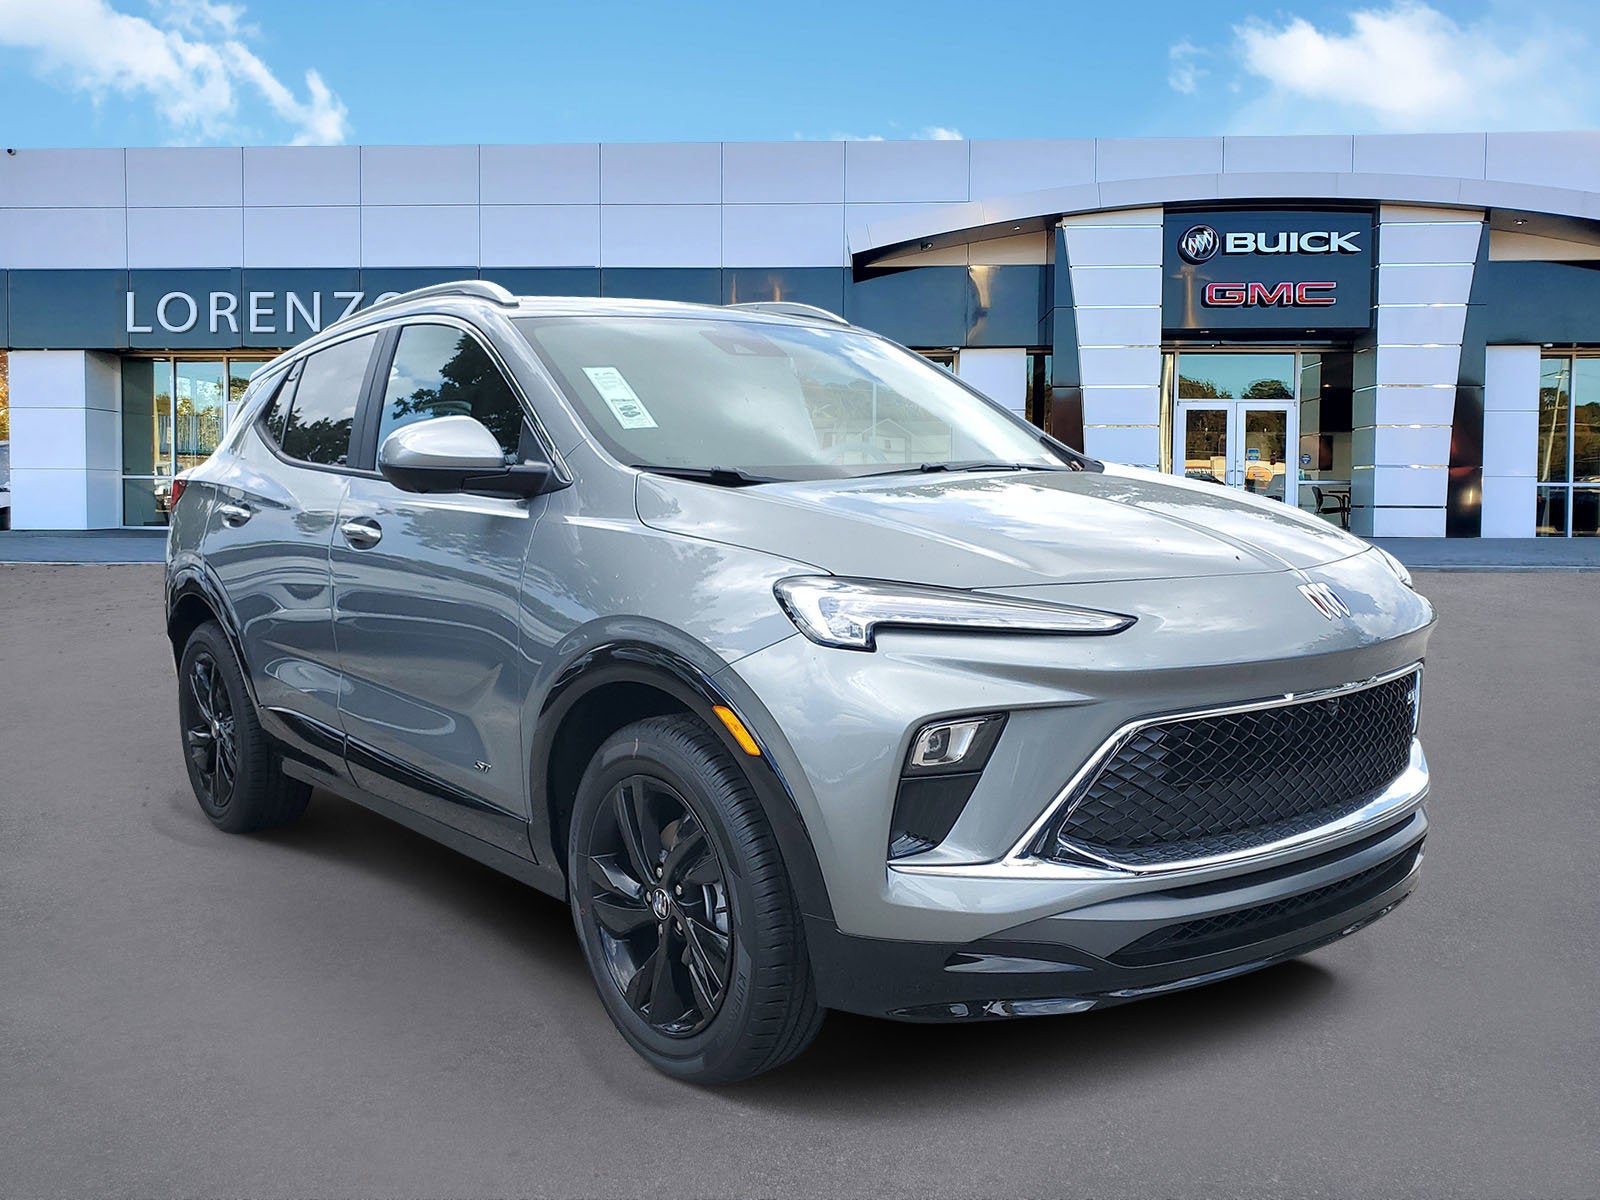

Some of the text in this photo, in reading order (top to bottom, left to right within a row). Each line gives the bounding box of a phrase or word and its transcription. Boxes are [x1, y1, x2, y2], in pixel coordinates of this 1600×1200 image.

[1226, 231, 1362, 253] BUICK
[1206, 281, 1337, 305] GMC
[126, 291, 403, 333] LORENZ
